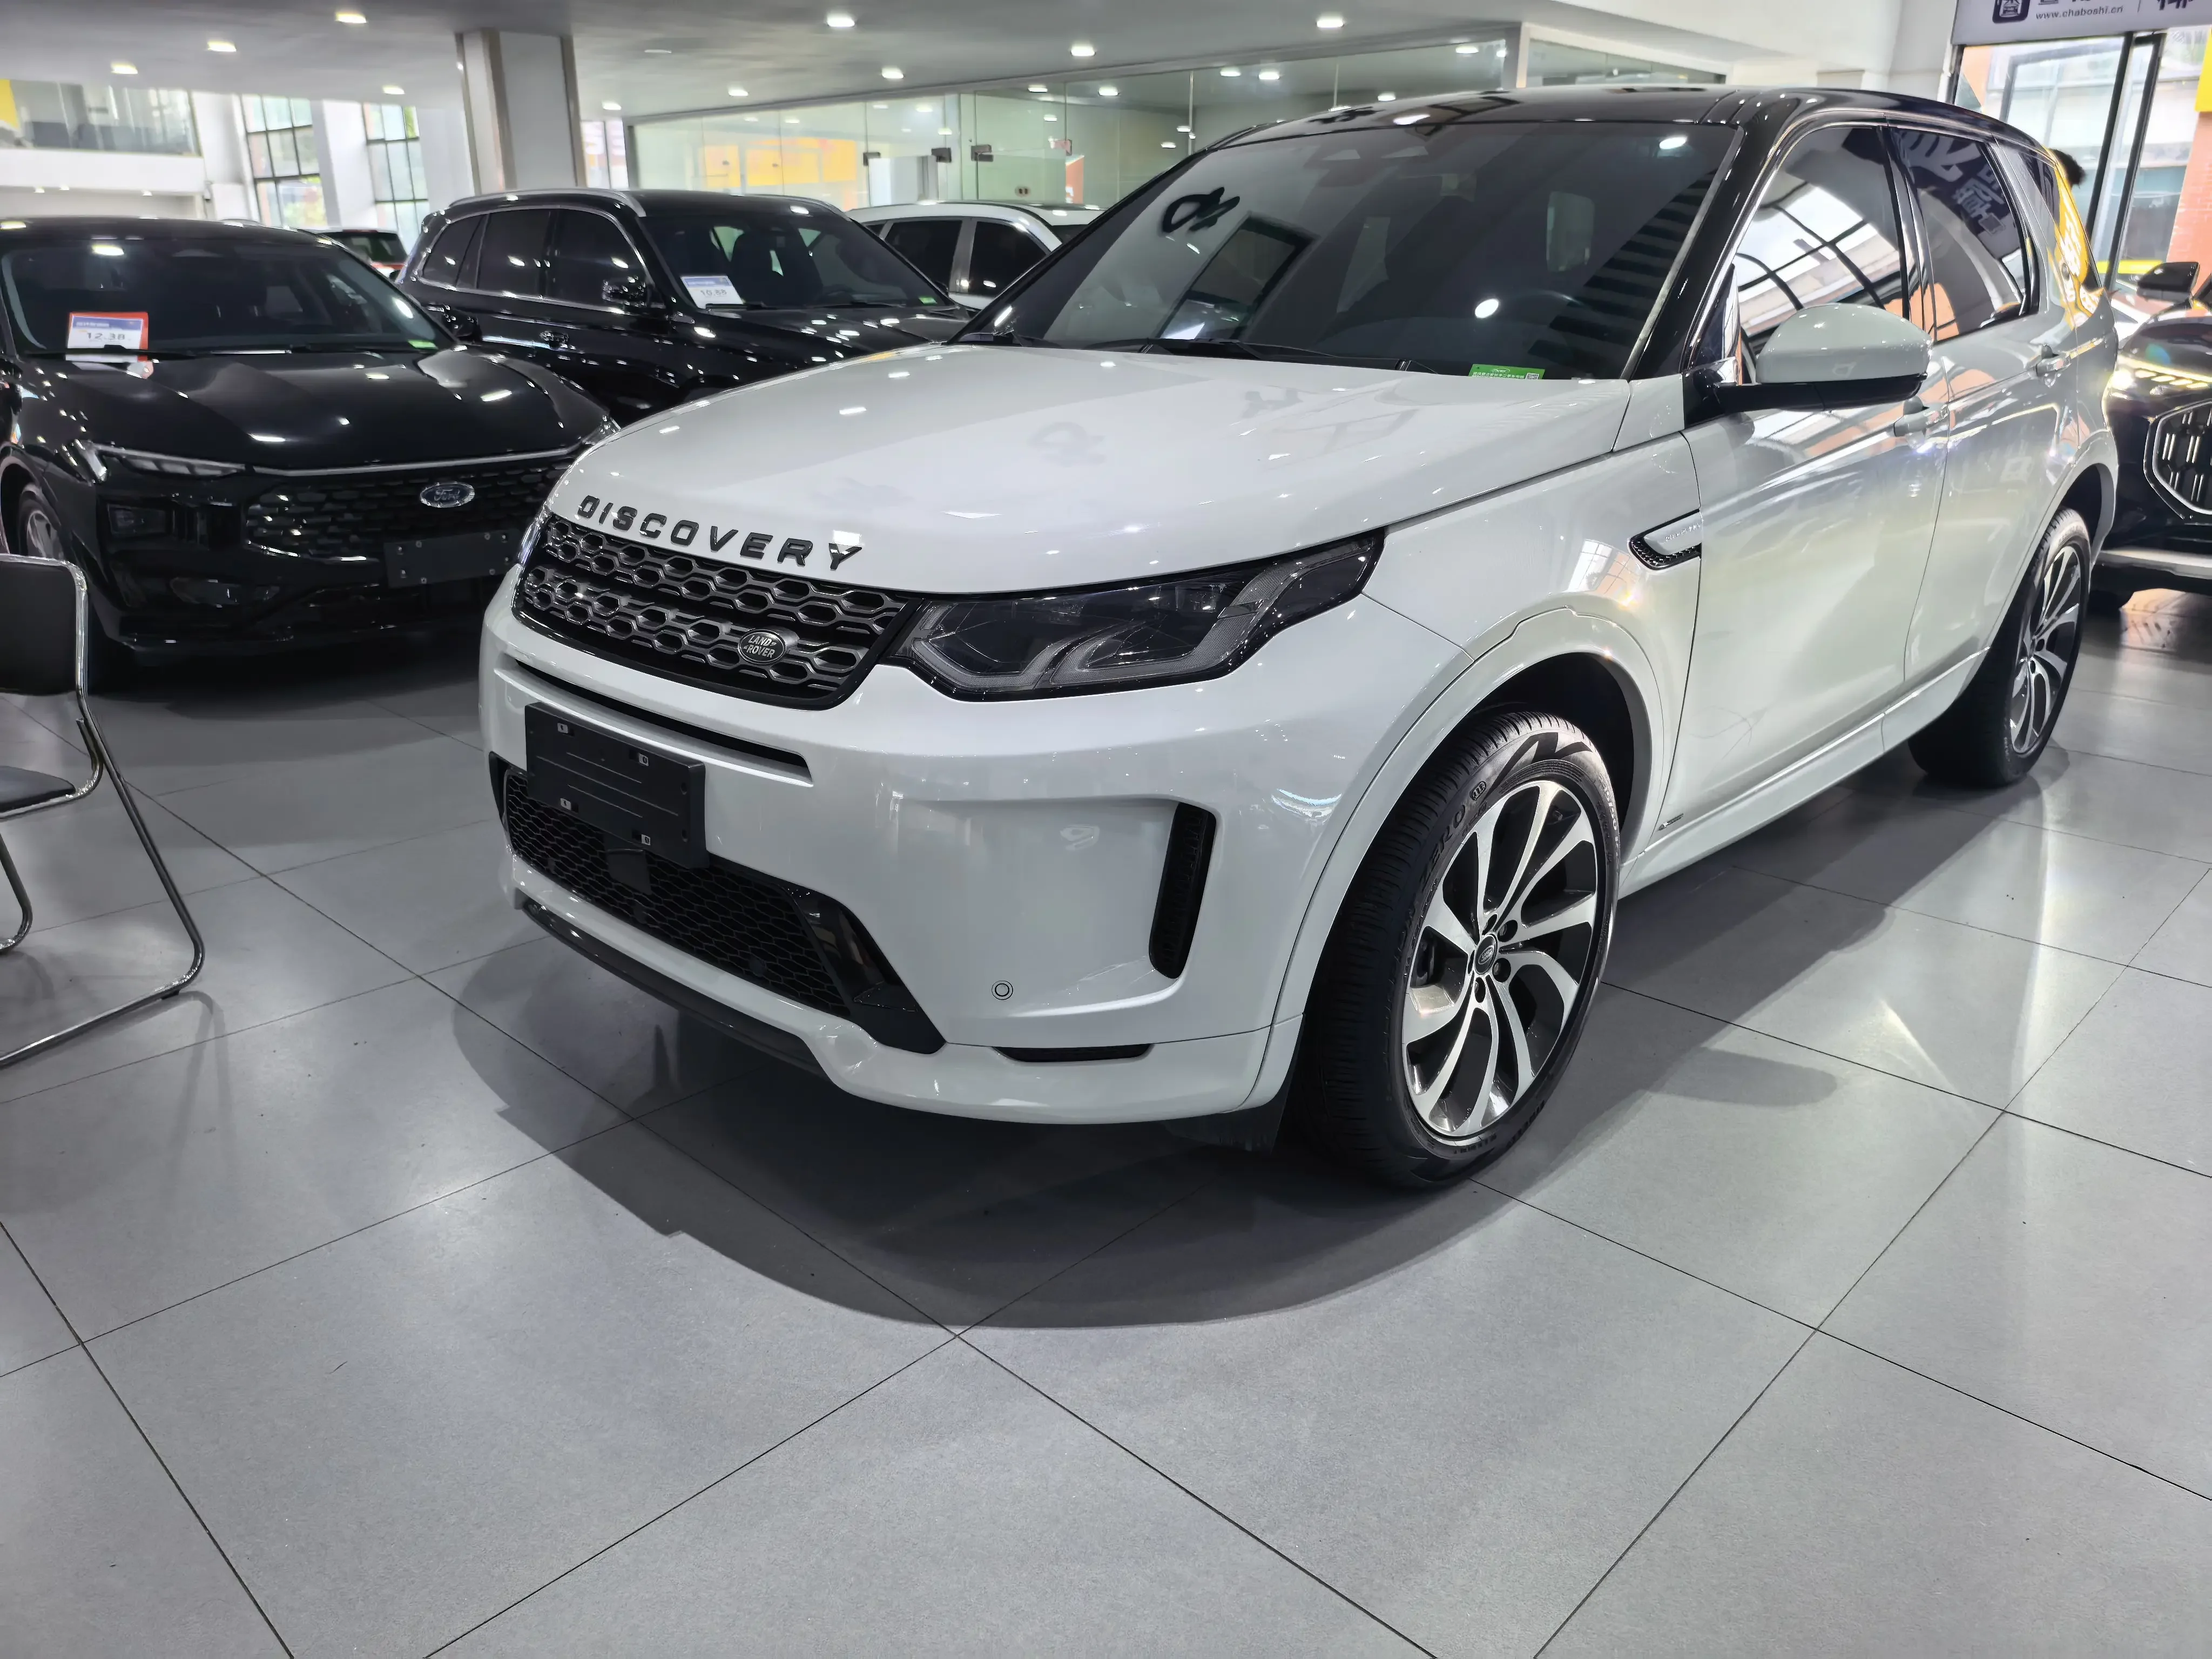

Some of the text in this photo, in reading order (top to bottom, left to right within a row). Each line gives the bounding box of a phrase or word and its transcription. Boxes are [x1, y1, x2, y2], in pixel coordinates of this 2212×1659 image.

[434, 488, 461, 501] Ford
[577, 495, 862, 571] DISCOVERY
[748, 635, 773, 647] LAND
[746, 644, 775, 658] ROVER
